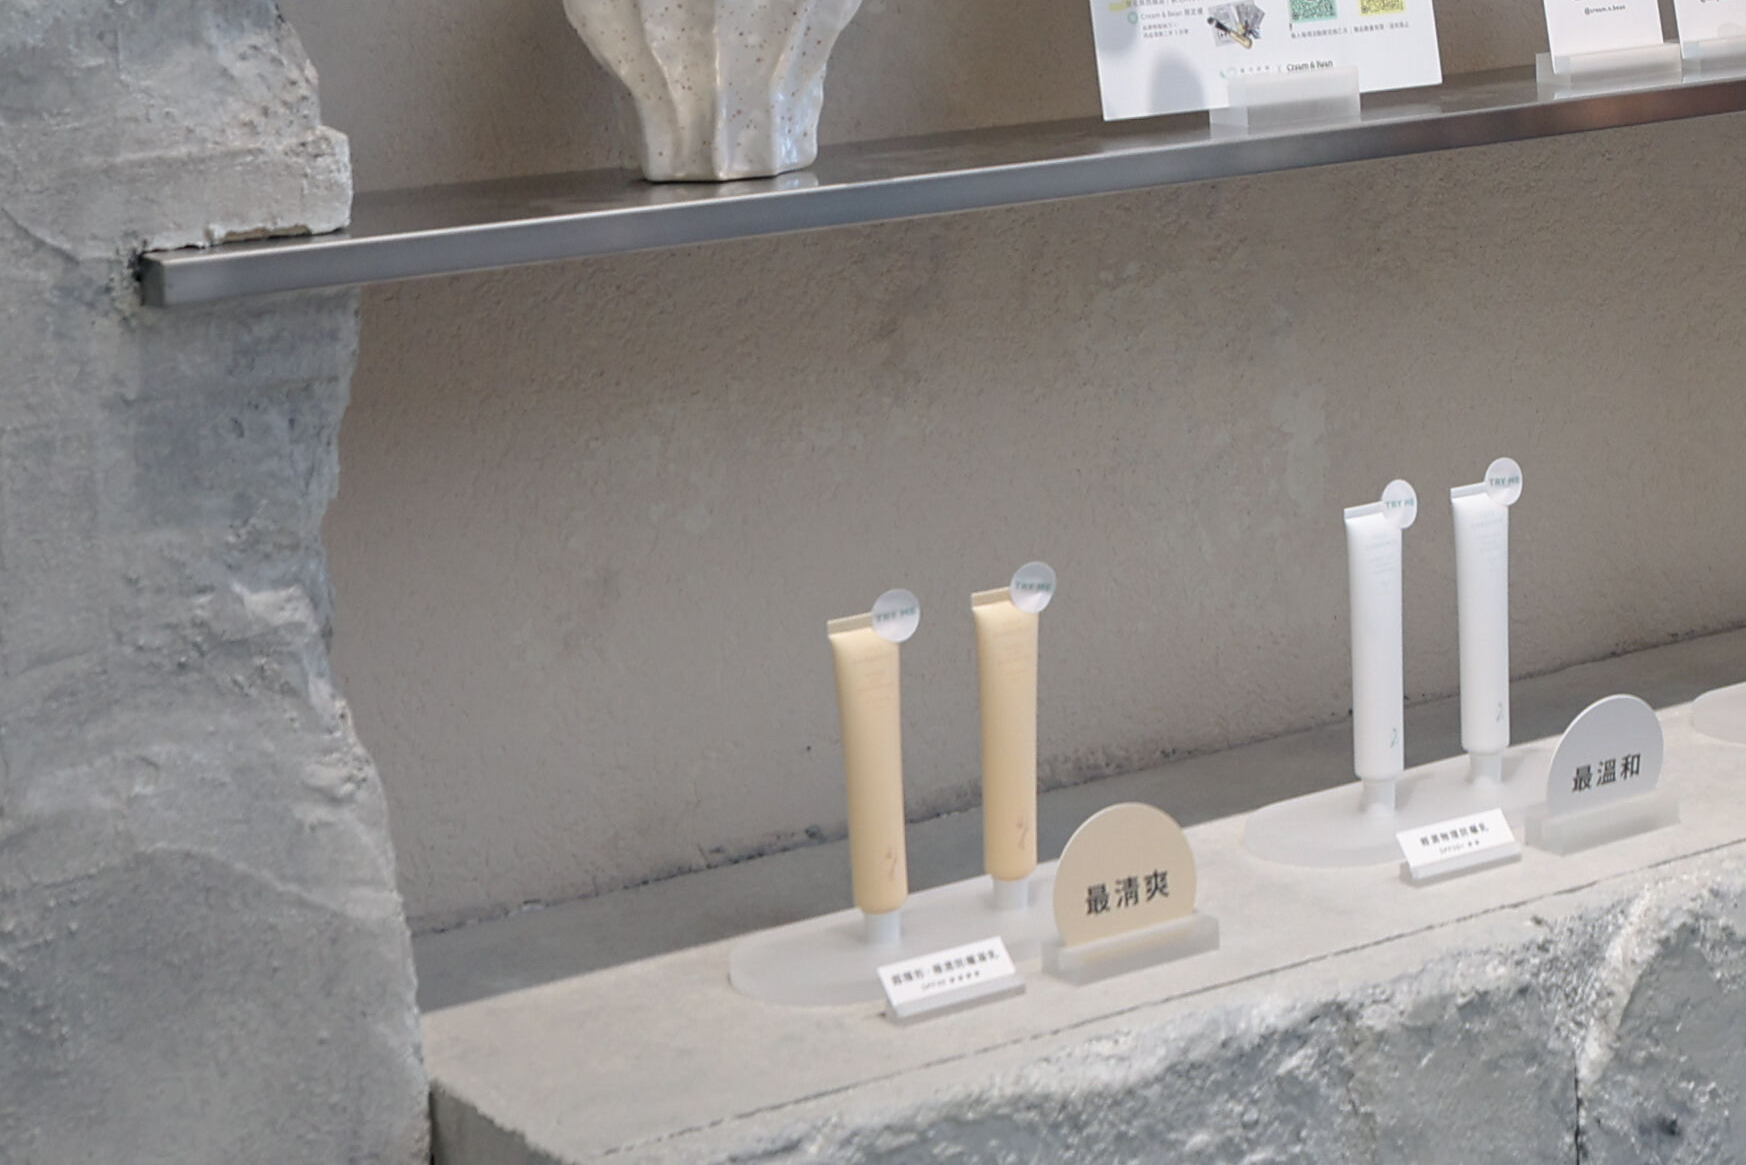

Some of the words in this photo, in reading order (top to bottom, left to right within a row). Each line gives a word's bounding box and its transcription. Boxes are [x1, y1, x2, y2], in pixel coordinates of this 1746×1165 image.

[1571, 753, 1641, 793] 最溫和
[1085, 868, 1170, 916] 最清爽
